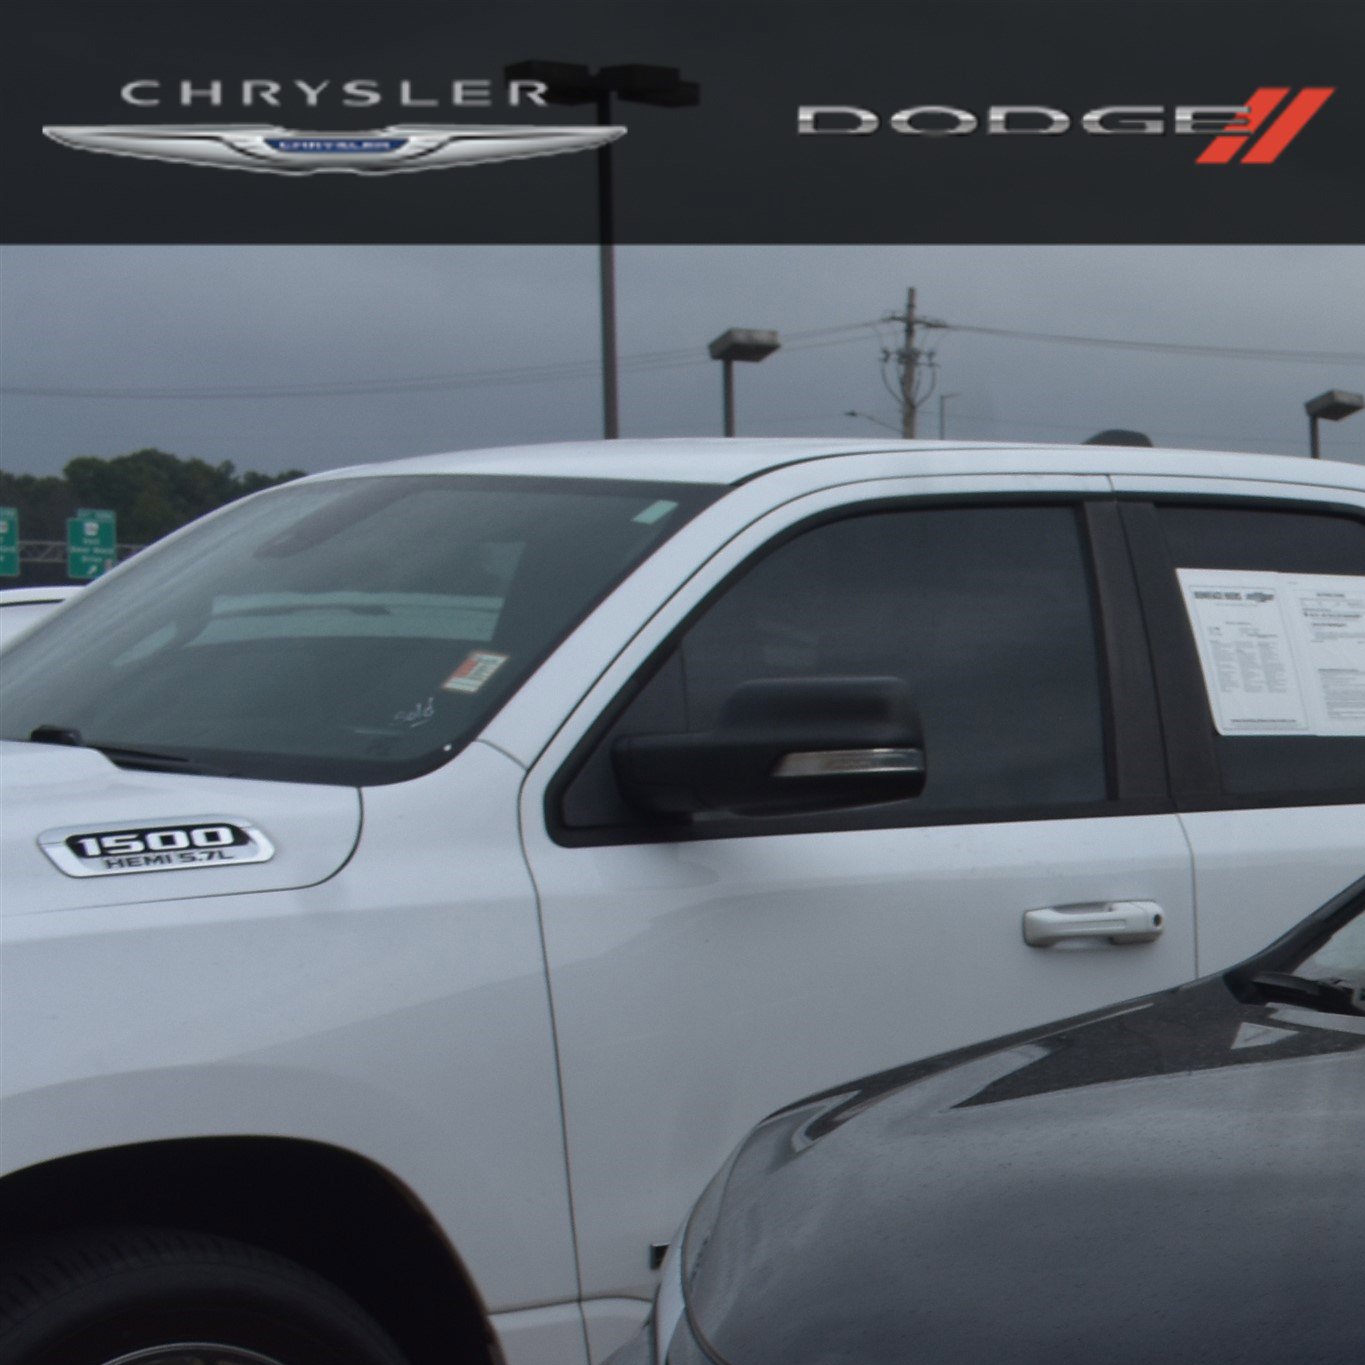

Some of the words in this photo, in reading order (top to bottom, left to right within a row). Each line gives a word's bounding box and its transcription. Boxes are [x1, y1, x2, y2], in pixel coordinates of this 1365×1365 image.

[76, 825, 235, 857] 1500
[105, 853, 171, 870] HEMI
[179, 850, 234, 864] 5.7L
